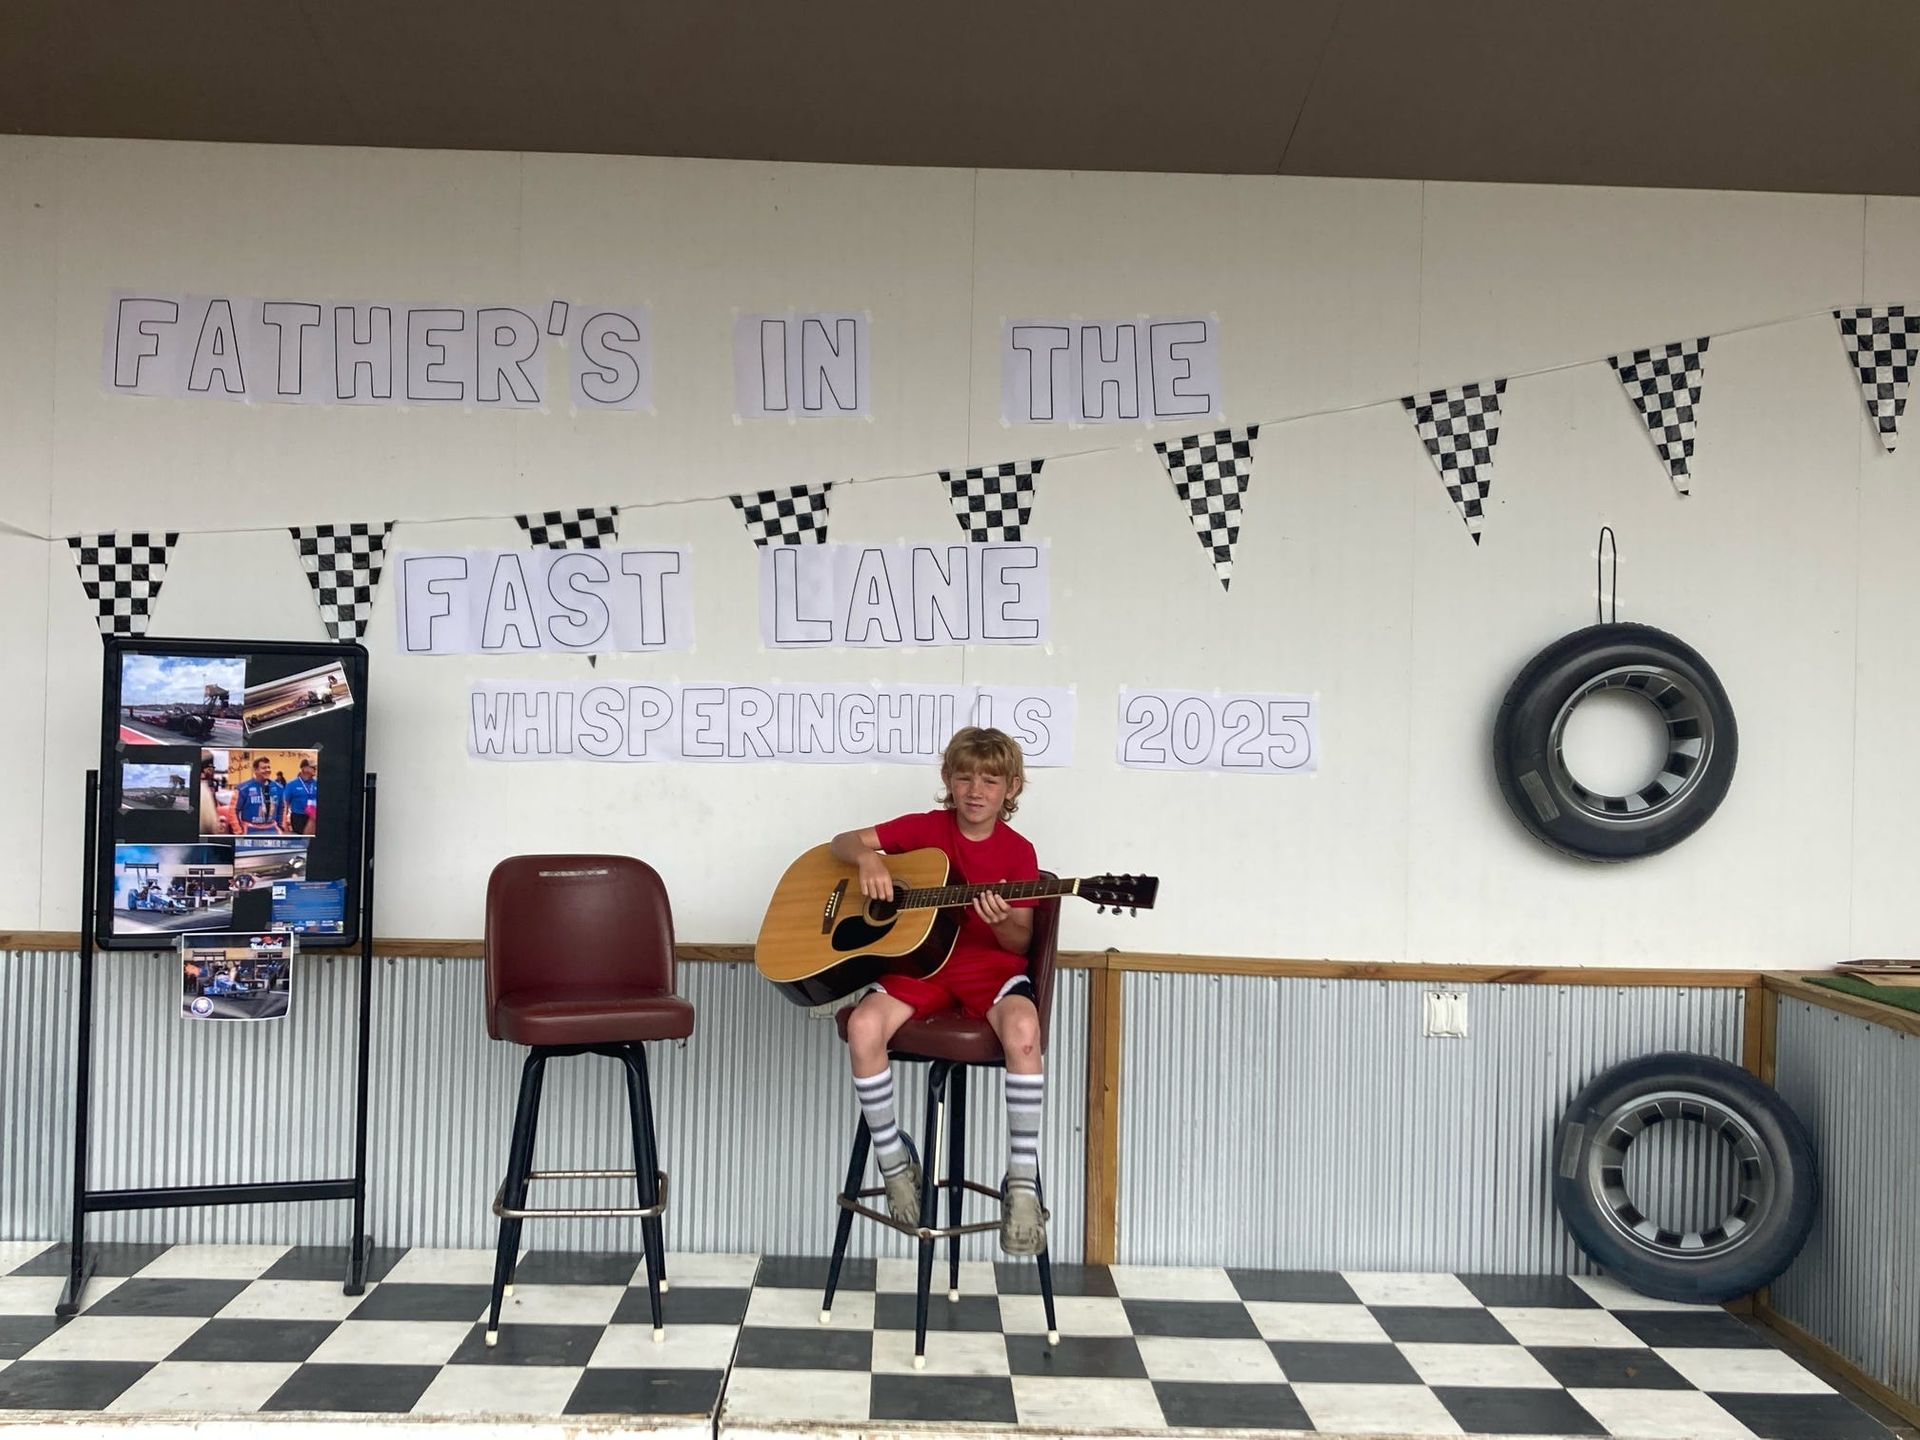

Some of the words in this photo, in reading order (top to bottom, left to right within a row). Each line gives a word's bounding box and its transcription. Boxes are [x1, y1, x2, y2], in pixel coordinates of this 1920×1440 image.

[115, 298, 641, 403] FATHER'S
[760, 318, 858, 412] IN
[1012, 320, 1211, 421] THE
[404, 552, 680, 652] FAST
[774, 546, 1039, 644] LANE
[1124, 696, 1311, 770] 2025
